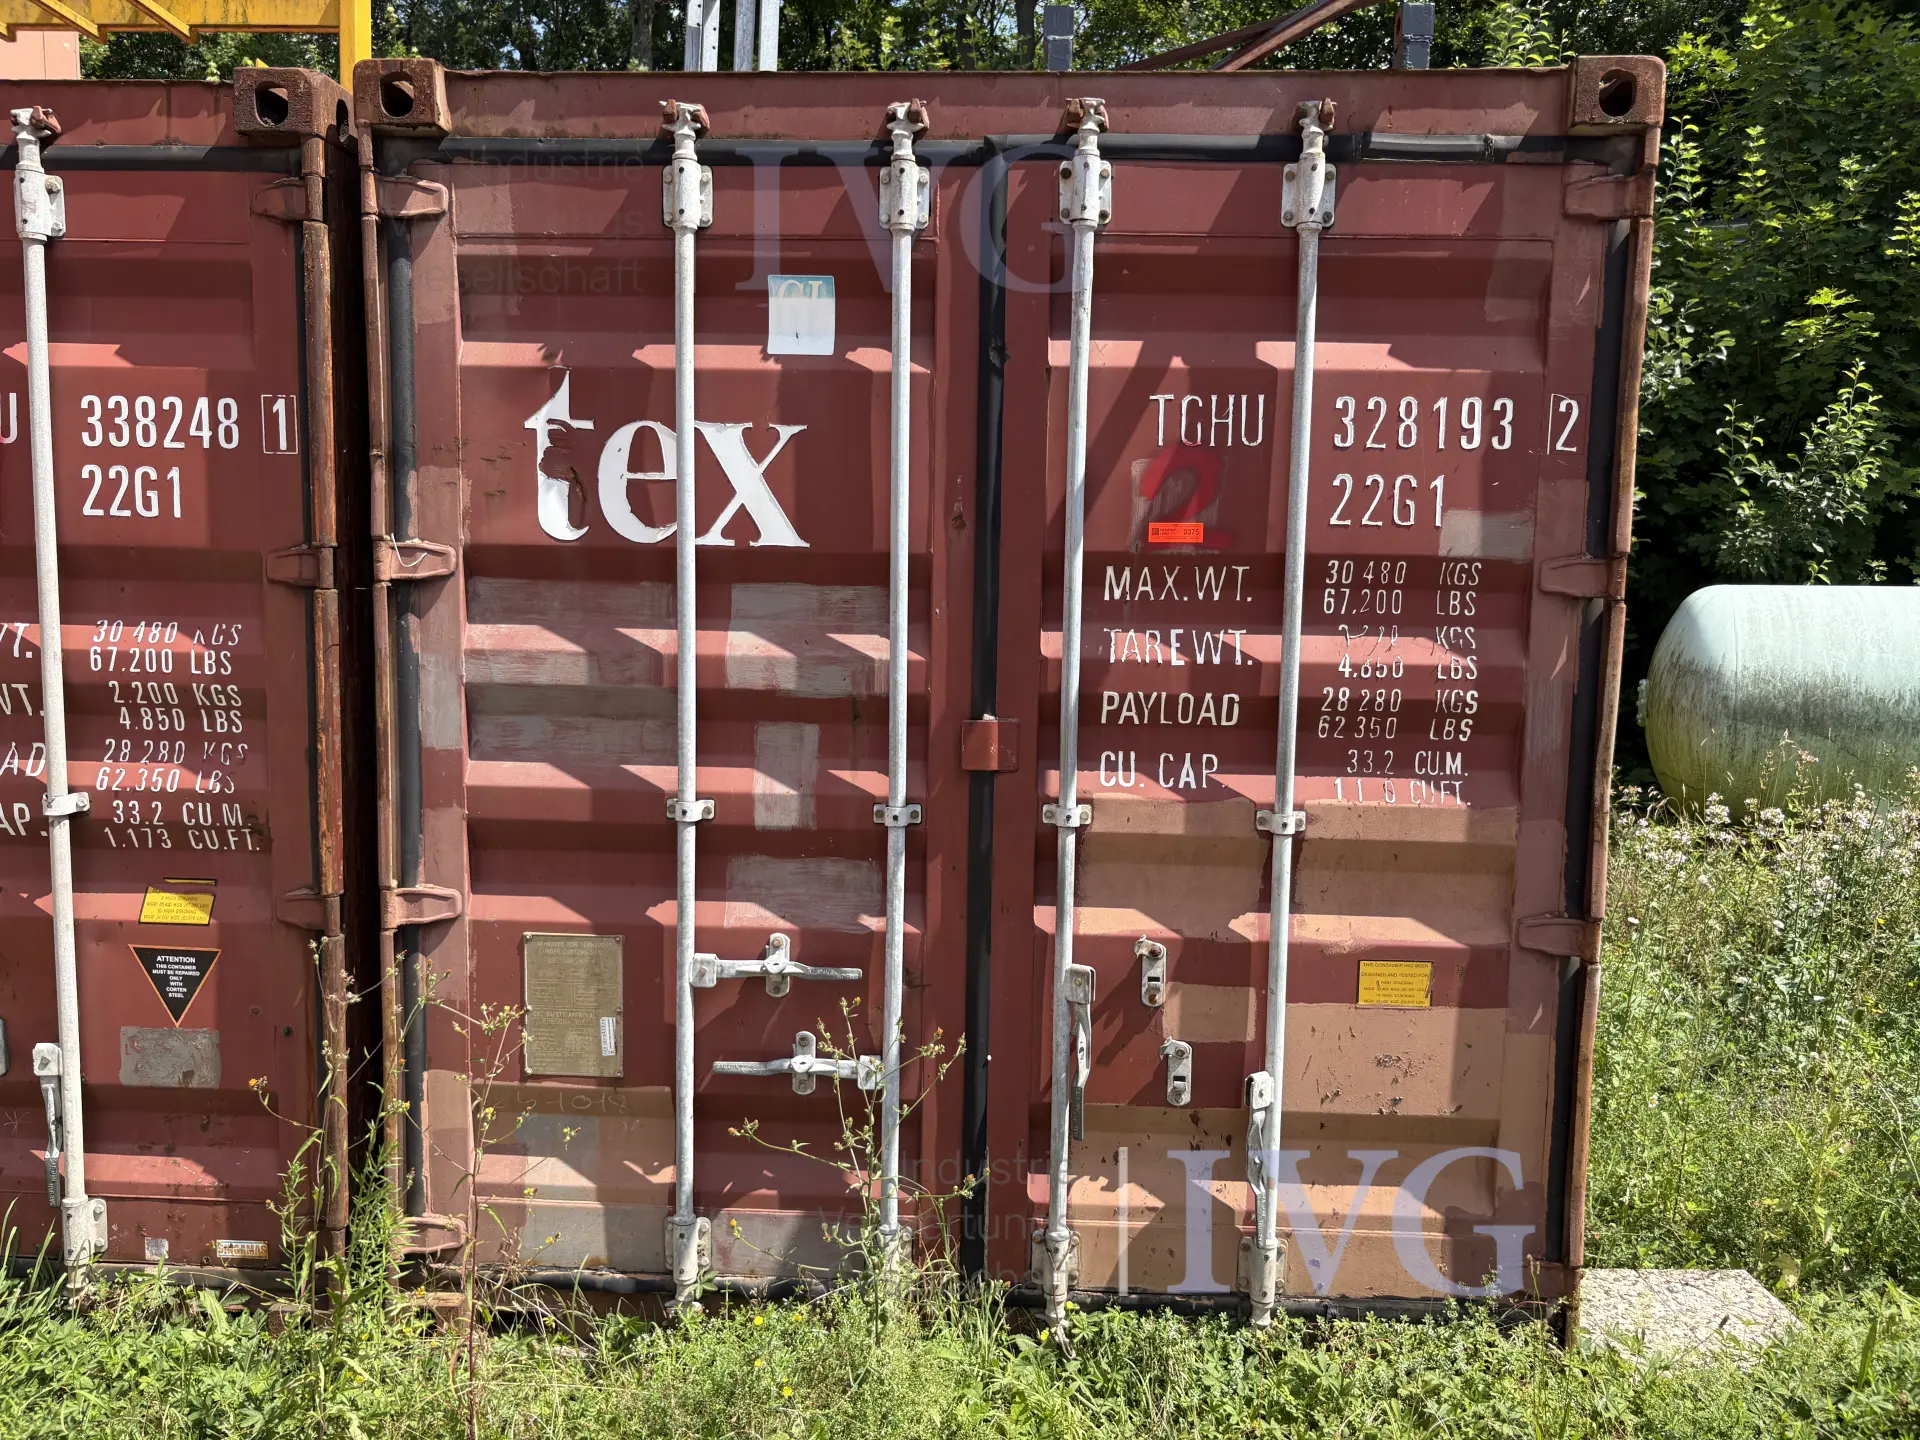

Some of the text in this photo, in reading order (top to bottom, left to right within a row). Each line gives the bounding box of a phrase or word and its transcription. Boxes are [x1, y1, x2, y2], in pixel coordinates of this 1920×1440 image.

[81, 395, 239, 449] 338248
[272, 398, 288, 450] 1
[1334, 395, 1515, 450] 328193
[1556, 399, 1580, 452] 2
[82, 464, 182, 518] 22G1
[1328, 473, 1447, 528] 22G1
[1183, 528, 1200, 536] 0375
[1439, 562, 1482, 586] KGS
[1436, 590, 1477, 616] LBS
[190, 648, 232, 675] LBS
[1437, 655, 1478, 680] LBS
[108, 680, 179, 705] 2.200
[192, 683, 242, 707] KGS
[119, 707, 243, 733] 4.850 LBS
[1100, 691, 1240, 726] PAYLOAD
[1435, 689, 1479, 714] KGS
[1429, 718, 1473, 742] LBS
[1346, 749, 1394, 775] 33.2
[95, 766, 181, 793] 62.350
[112, 800, 164, 826] 33.2
[104, 827, 172, 849] 1.173
[568, 1011, 597, 1019] APPROVAL
